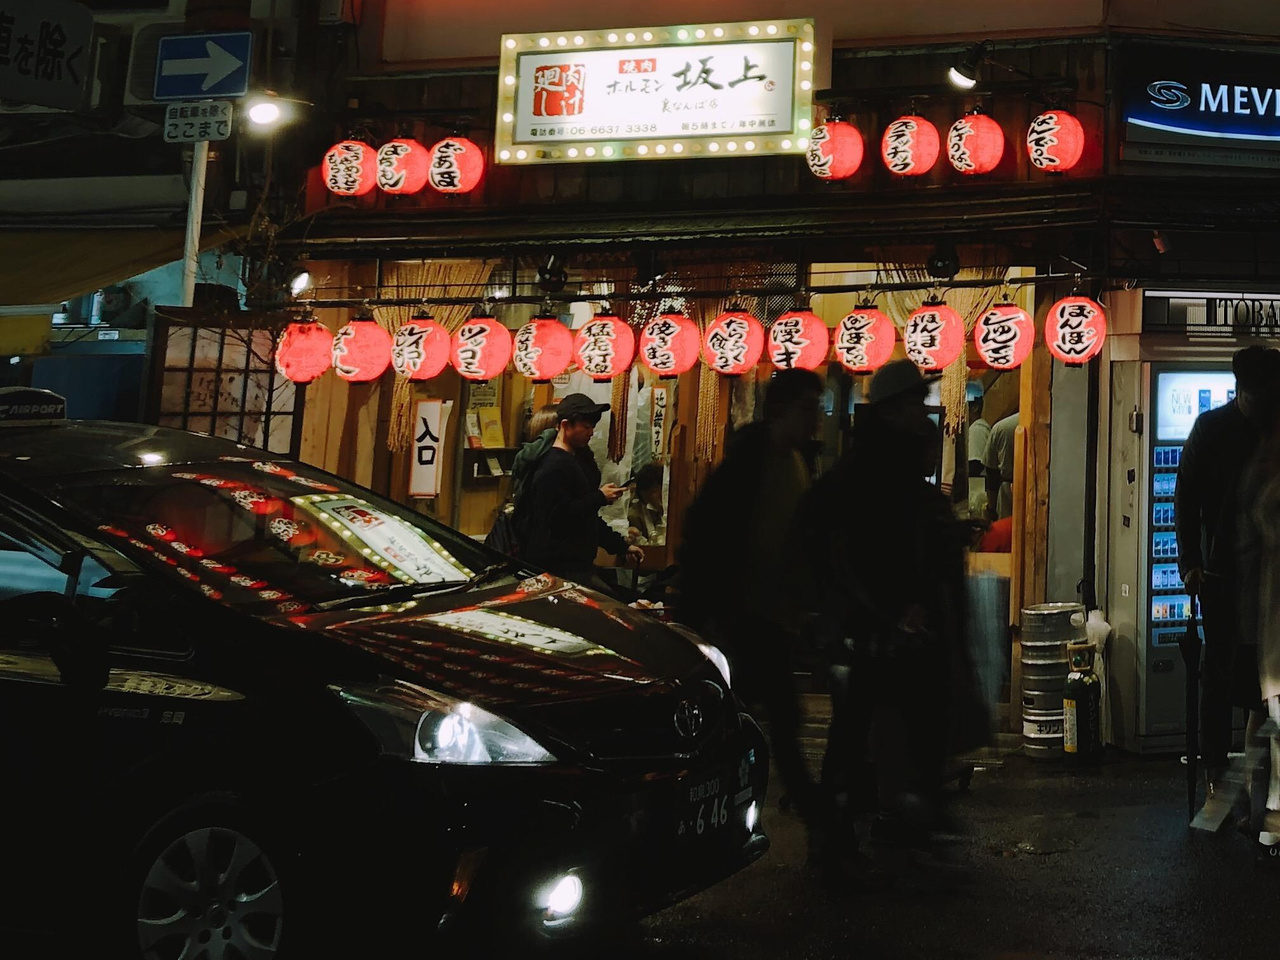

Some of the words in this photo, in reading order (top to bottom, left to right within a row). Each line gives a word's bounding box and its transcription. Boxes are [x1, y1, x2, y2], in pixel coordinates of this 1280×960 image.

[606, 78, 665, 96] ホルモン
[622, 60, 655, 74] 焼肉
[672, 56, 767, 93] 坂上
[166, 121, 229, 139] ここまで
[168, 104, 228, 120] 自転車を除く
[377, 143, 410, 190] ぱちもん
[430, 142, 464, 188] どあほ
[459, 326, 489, 374] ツッコミ
[580, 322, 615, 374] 猛虎打線
[645, 320, 680, 369] 焼きまっせ
[772, 319, 809, 367] 漫才
[1054, 304, 1096, 356] ぼんぼん
[9, 404, 65, 416] AIRPORT
[416, 416, 439, 466] 入口
[1036, 723, 1060, 734] キリン
